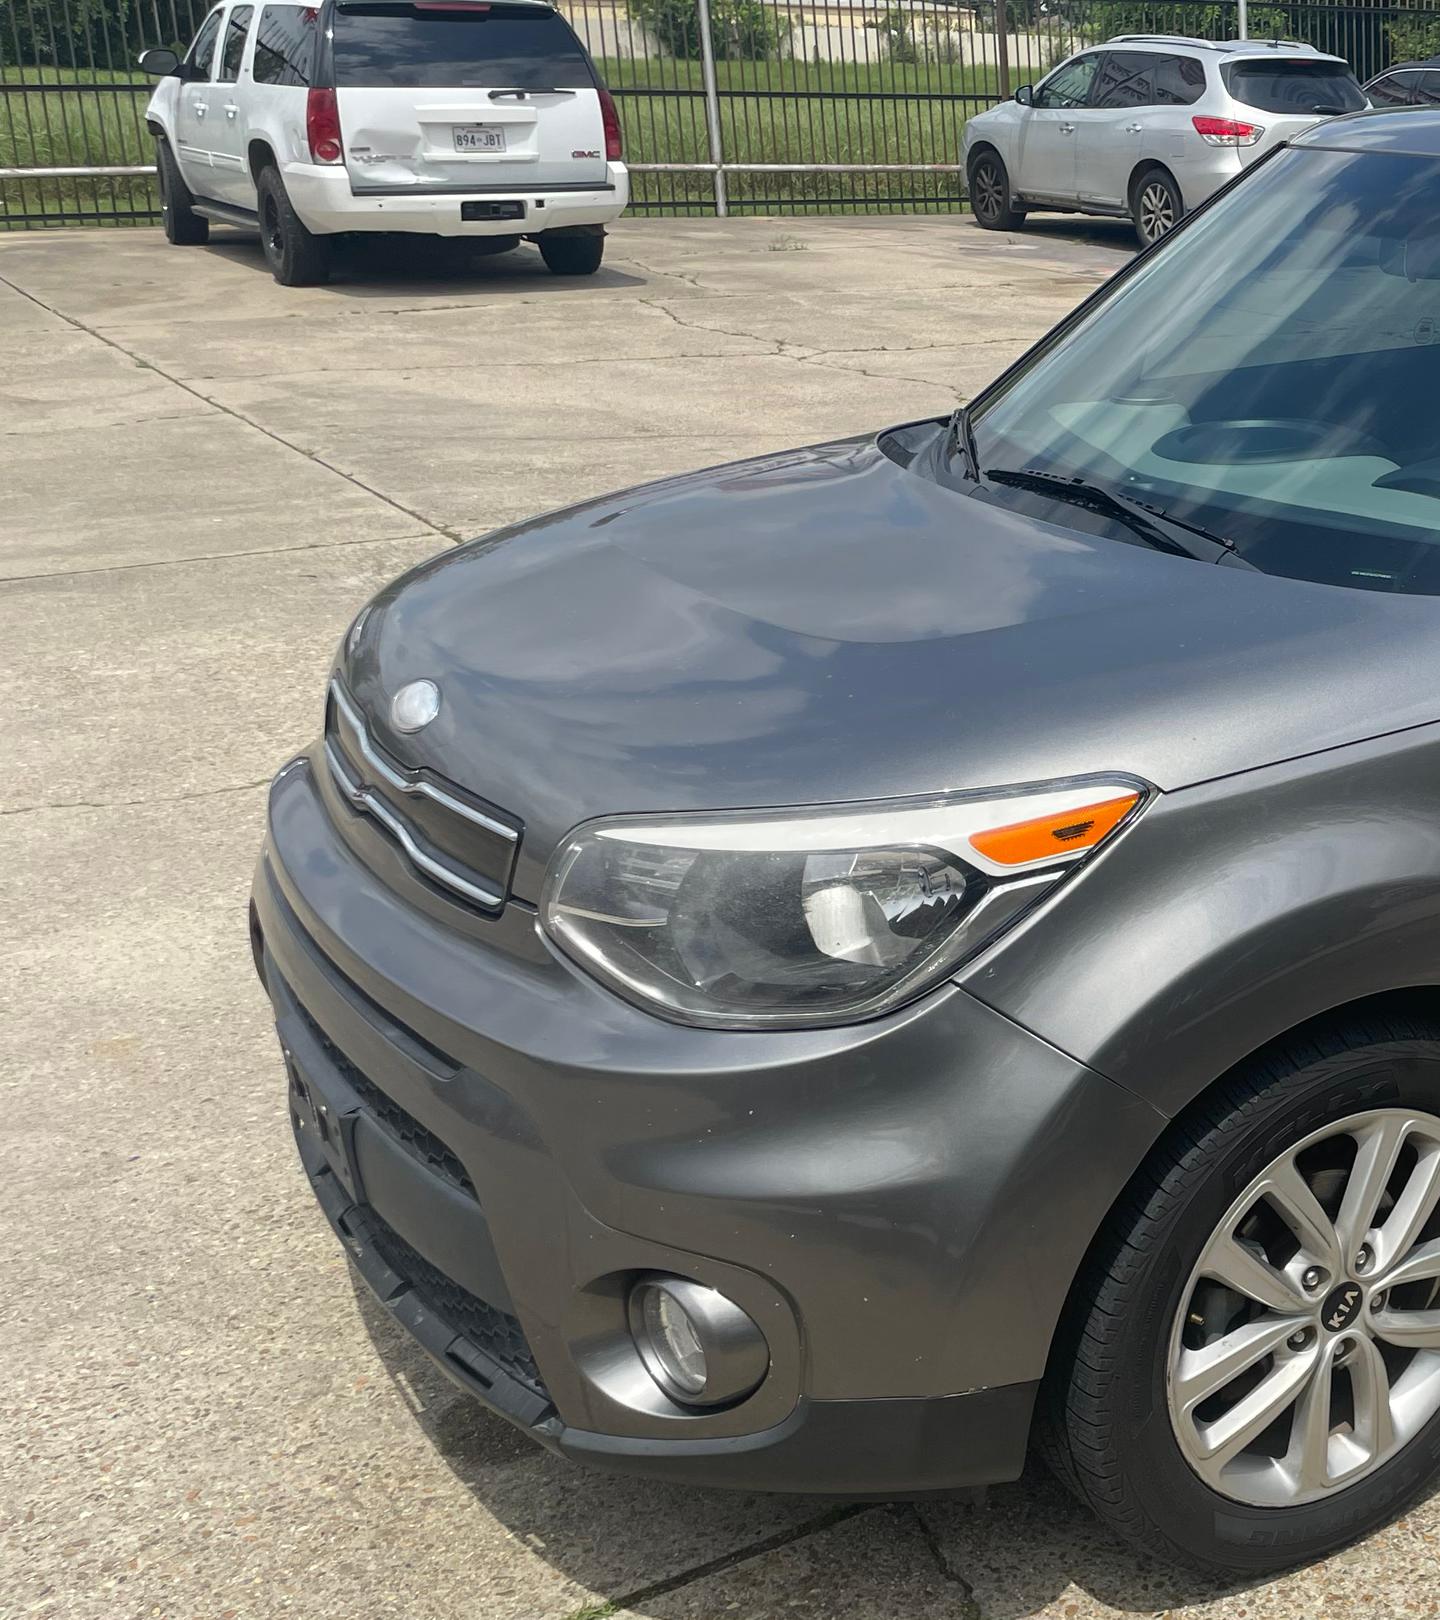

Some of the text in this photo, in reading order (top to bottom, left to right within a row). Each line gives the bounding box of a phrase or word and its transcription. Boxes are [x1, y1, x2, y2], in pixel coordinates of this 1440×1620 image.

[456, 134, 501, 146] 894 JBT
[571, 150, 600, 158] GMC
[1327, 1291, 1359, 1328] KIA
